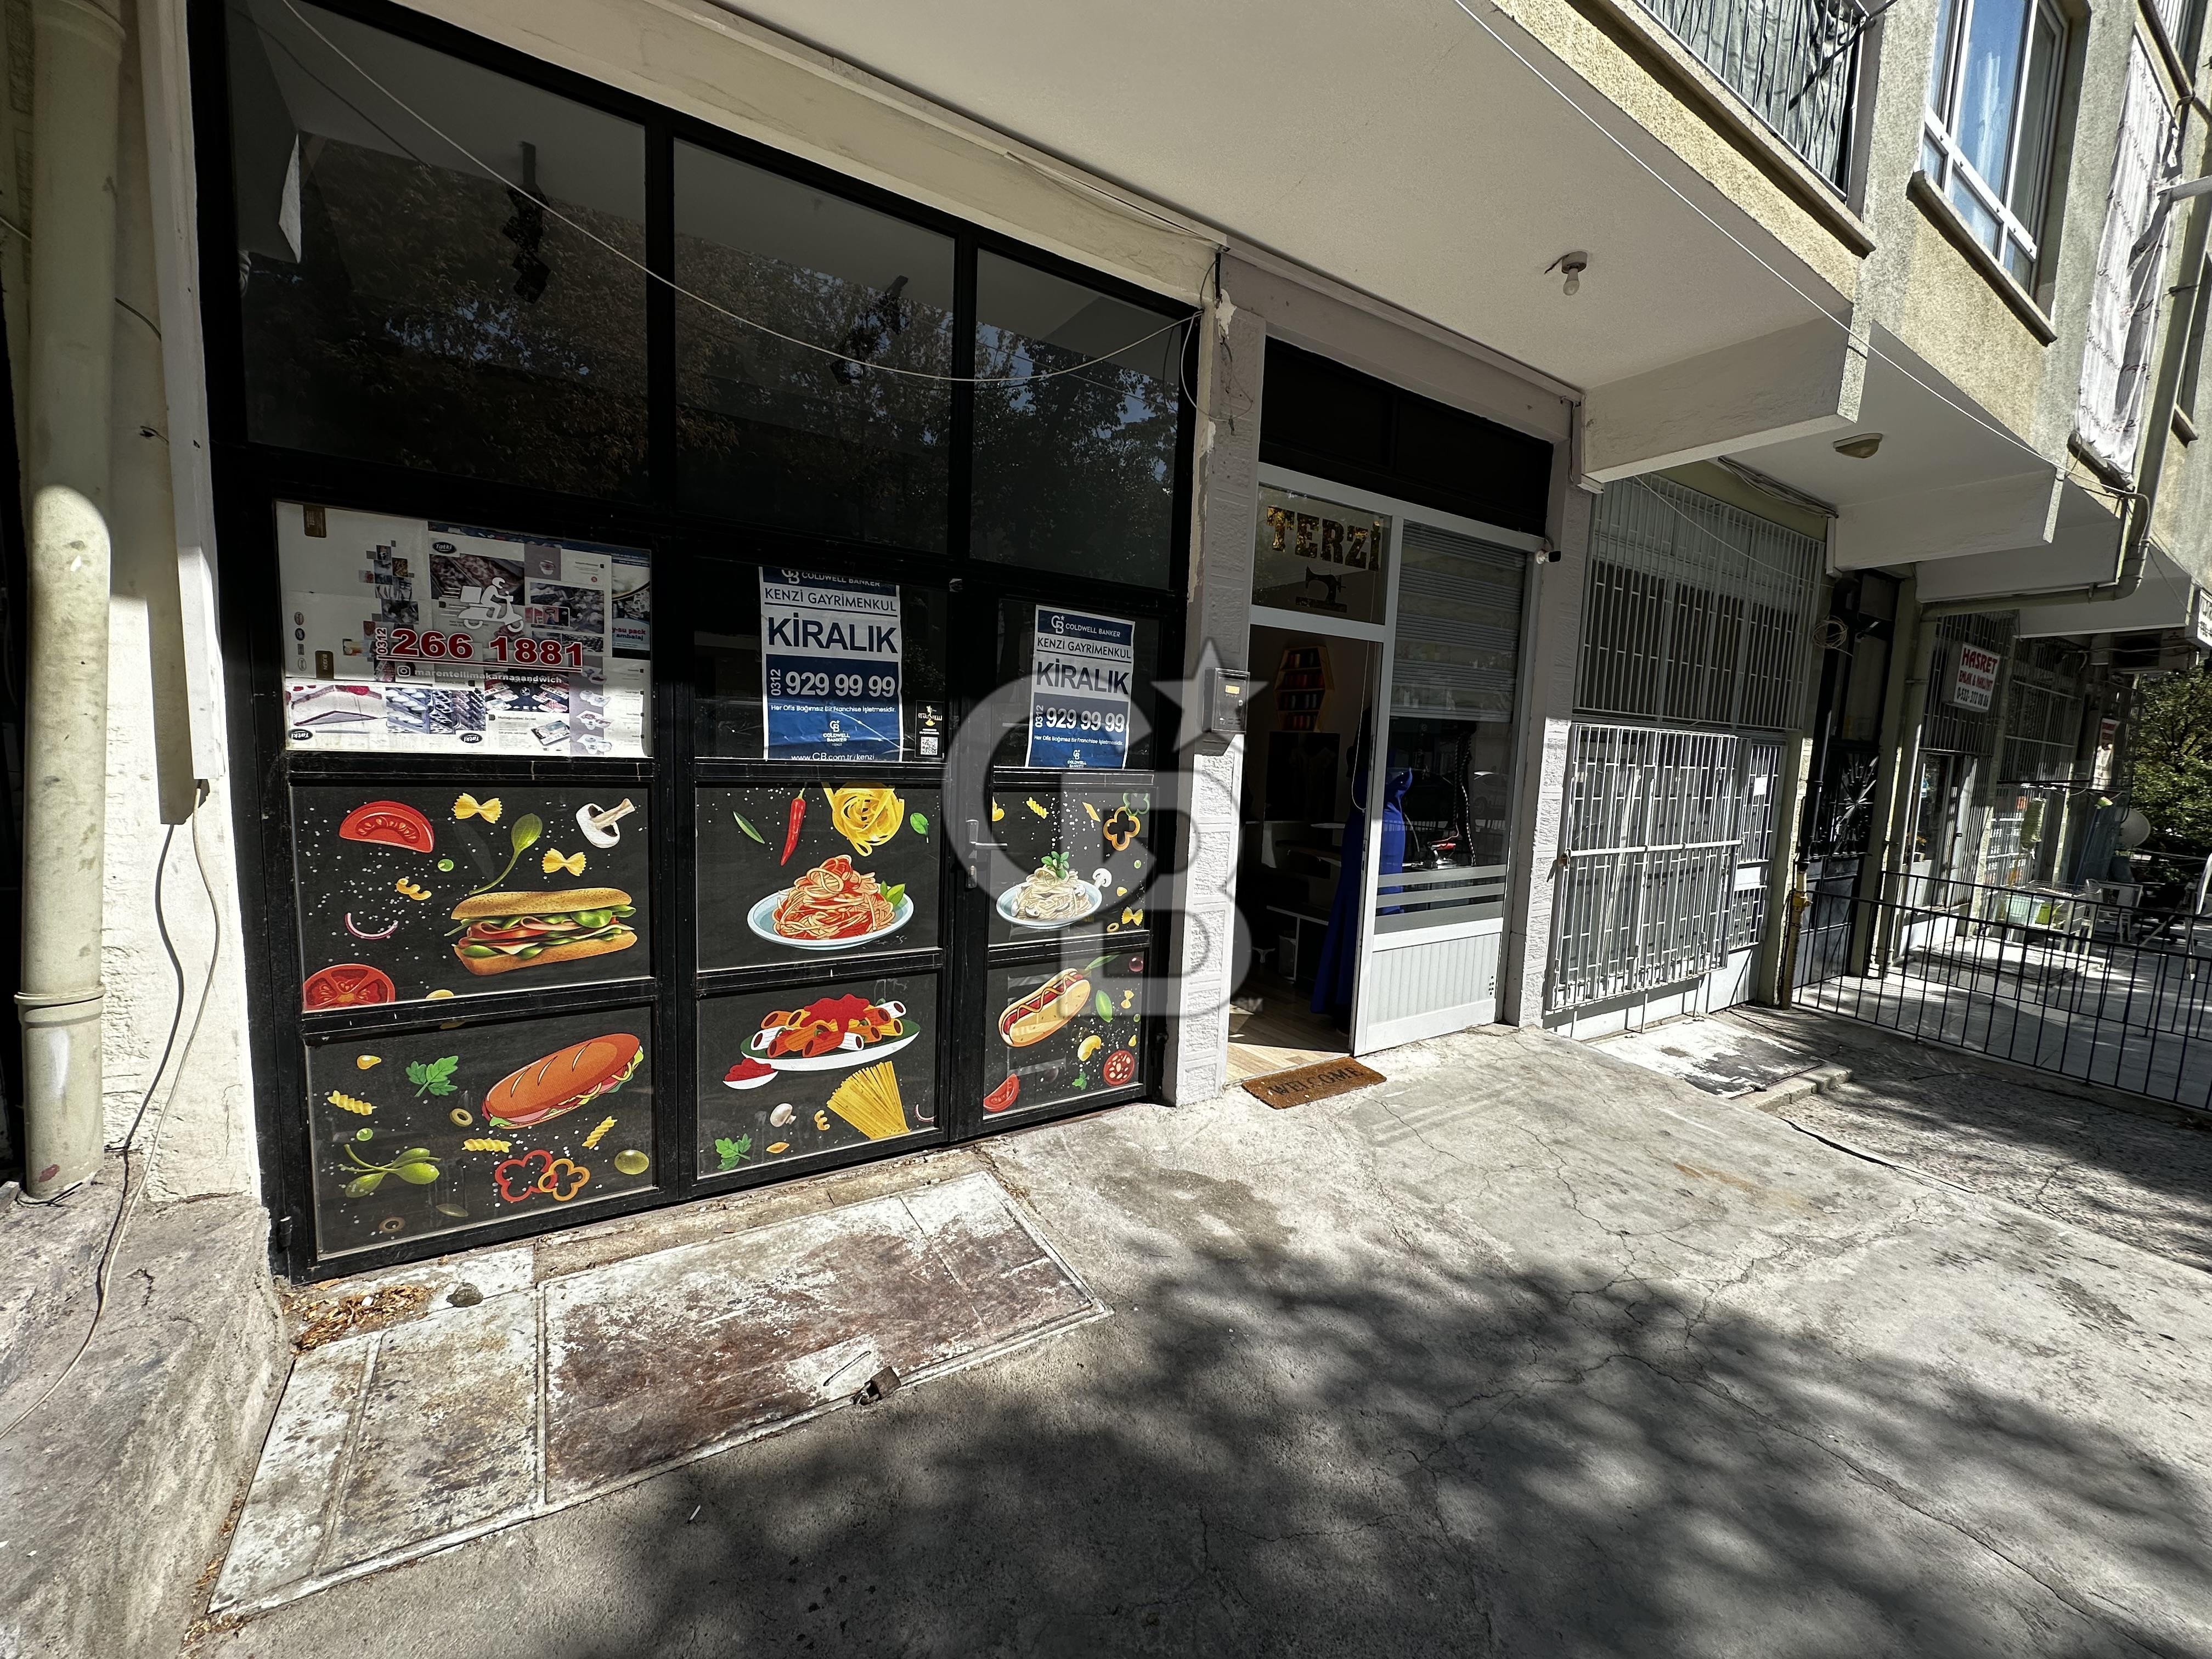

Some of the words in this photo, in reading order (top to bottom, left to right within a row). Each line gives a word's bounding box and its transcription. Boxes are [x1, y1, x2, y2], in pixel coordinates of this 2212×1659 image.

[1266, 505, 1383, 572] TERZİ
[765, 588, 803, 602] KENZİ
[808, 592, 896, 611] GAYRİMENKUL
[768, 612, 898, 654] KİRALIK
[1065, 623, 1097, 634] COLDWELL
[1098, 628, 1121, 637] BANKER
[376, 627, 388, 655] 0312
[391, 628, 473, 660] 266
[489, 635, 583, 668] 1881
[1037, 637, 1065, 650] KENZİ
[1068, 641, 1131, 658] GAYRİMENKUL
[1962, 647, 1997, 674] HASRET
[770, 669, 781, 696] 0312
[785, 671, 830, 696] 929
[835, 673, 863, 697] 99
[868, 675, 896, 697] 99
[1036, 658, 1130, 695] KİRALIK
[1035, 704, 1043, 728] 0312
[1046, 707, 1077, 729] 929
[1080, 711, 1102, 731] 99
[1105, 713, 1125, 732] 99
[1267, 1067, 1364, 1096] WELCOME
